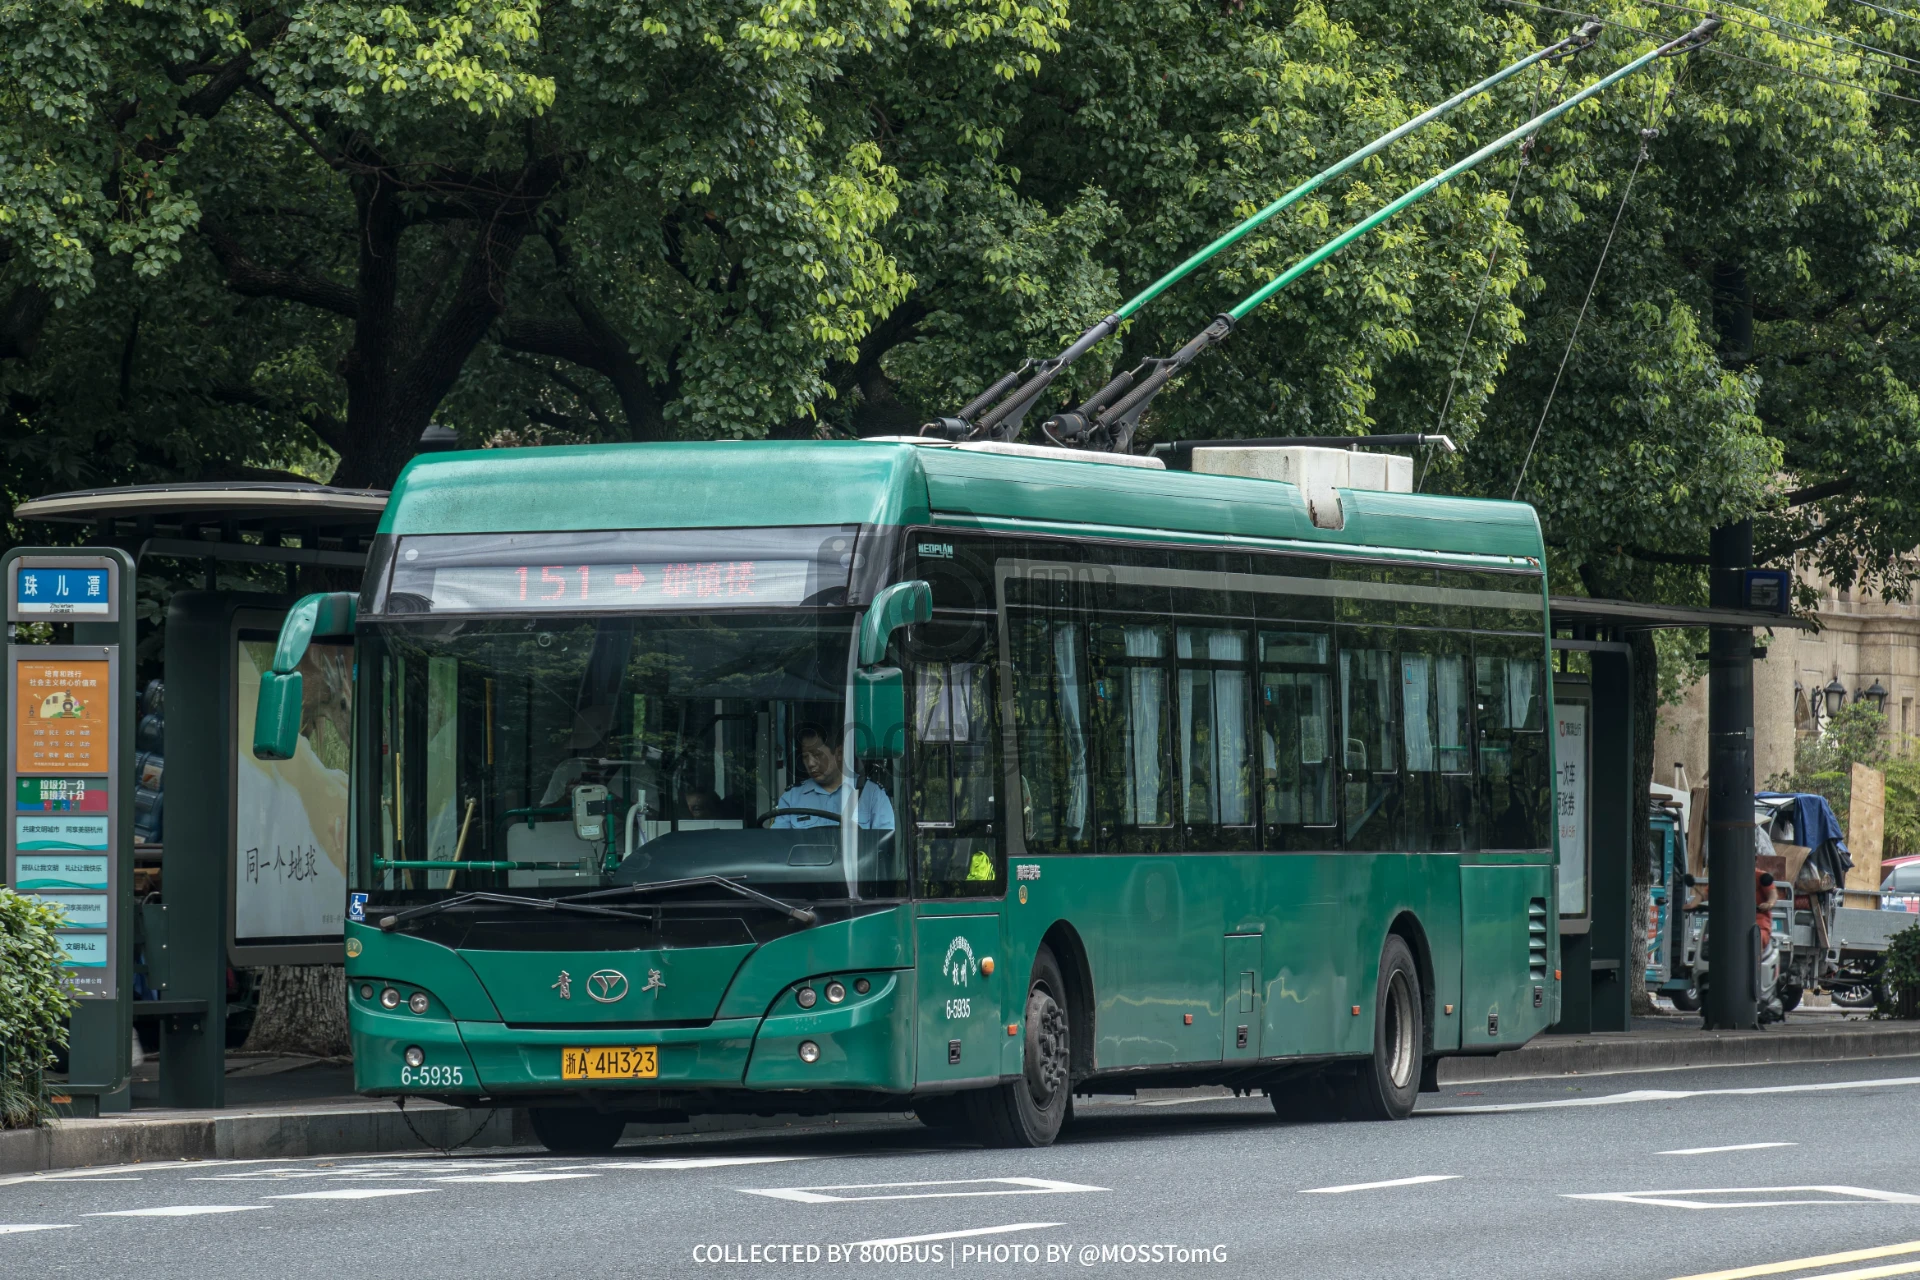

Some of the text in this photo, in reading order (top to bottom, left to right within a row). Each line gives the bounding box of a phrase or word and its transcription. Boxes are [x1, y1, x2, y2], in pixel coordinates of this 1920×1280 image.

[918, 543, 953, 558] NEOPLAN
[24, 574, 101, 597] 珠儿潭
[514, 565, 590, 601] 151
[44, 670, 82, 678] 培育和践行
[29, 679, 97, 687] 社会主义核心价值观
[40, 780, 85, 790] 垃圾分一分
[40, 790, 85, 800] 环境美十分
[22, 825, 103, 834] 共建文明城市 同享美丽杭州
[21, 864, 102, 872] 排队让我文明 礼让让我快乐
[246, 845, 318, 885] 同一个地球
[65, 942, 96, 951] 文明礼让
[946, 998, 971, 1019] 6-5935
[401, 1065, 463, 1086] 6-5935
